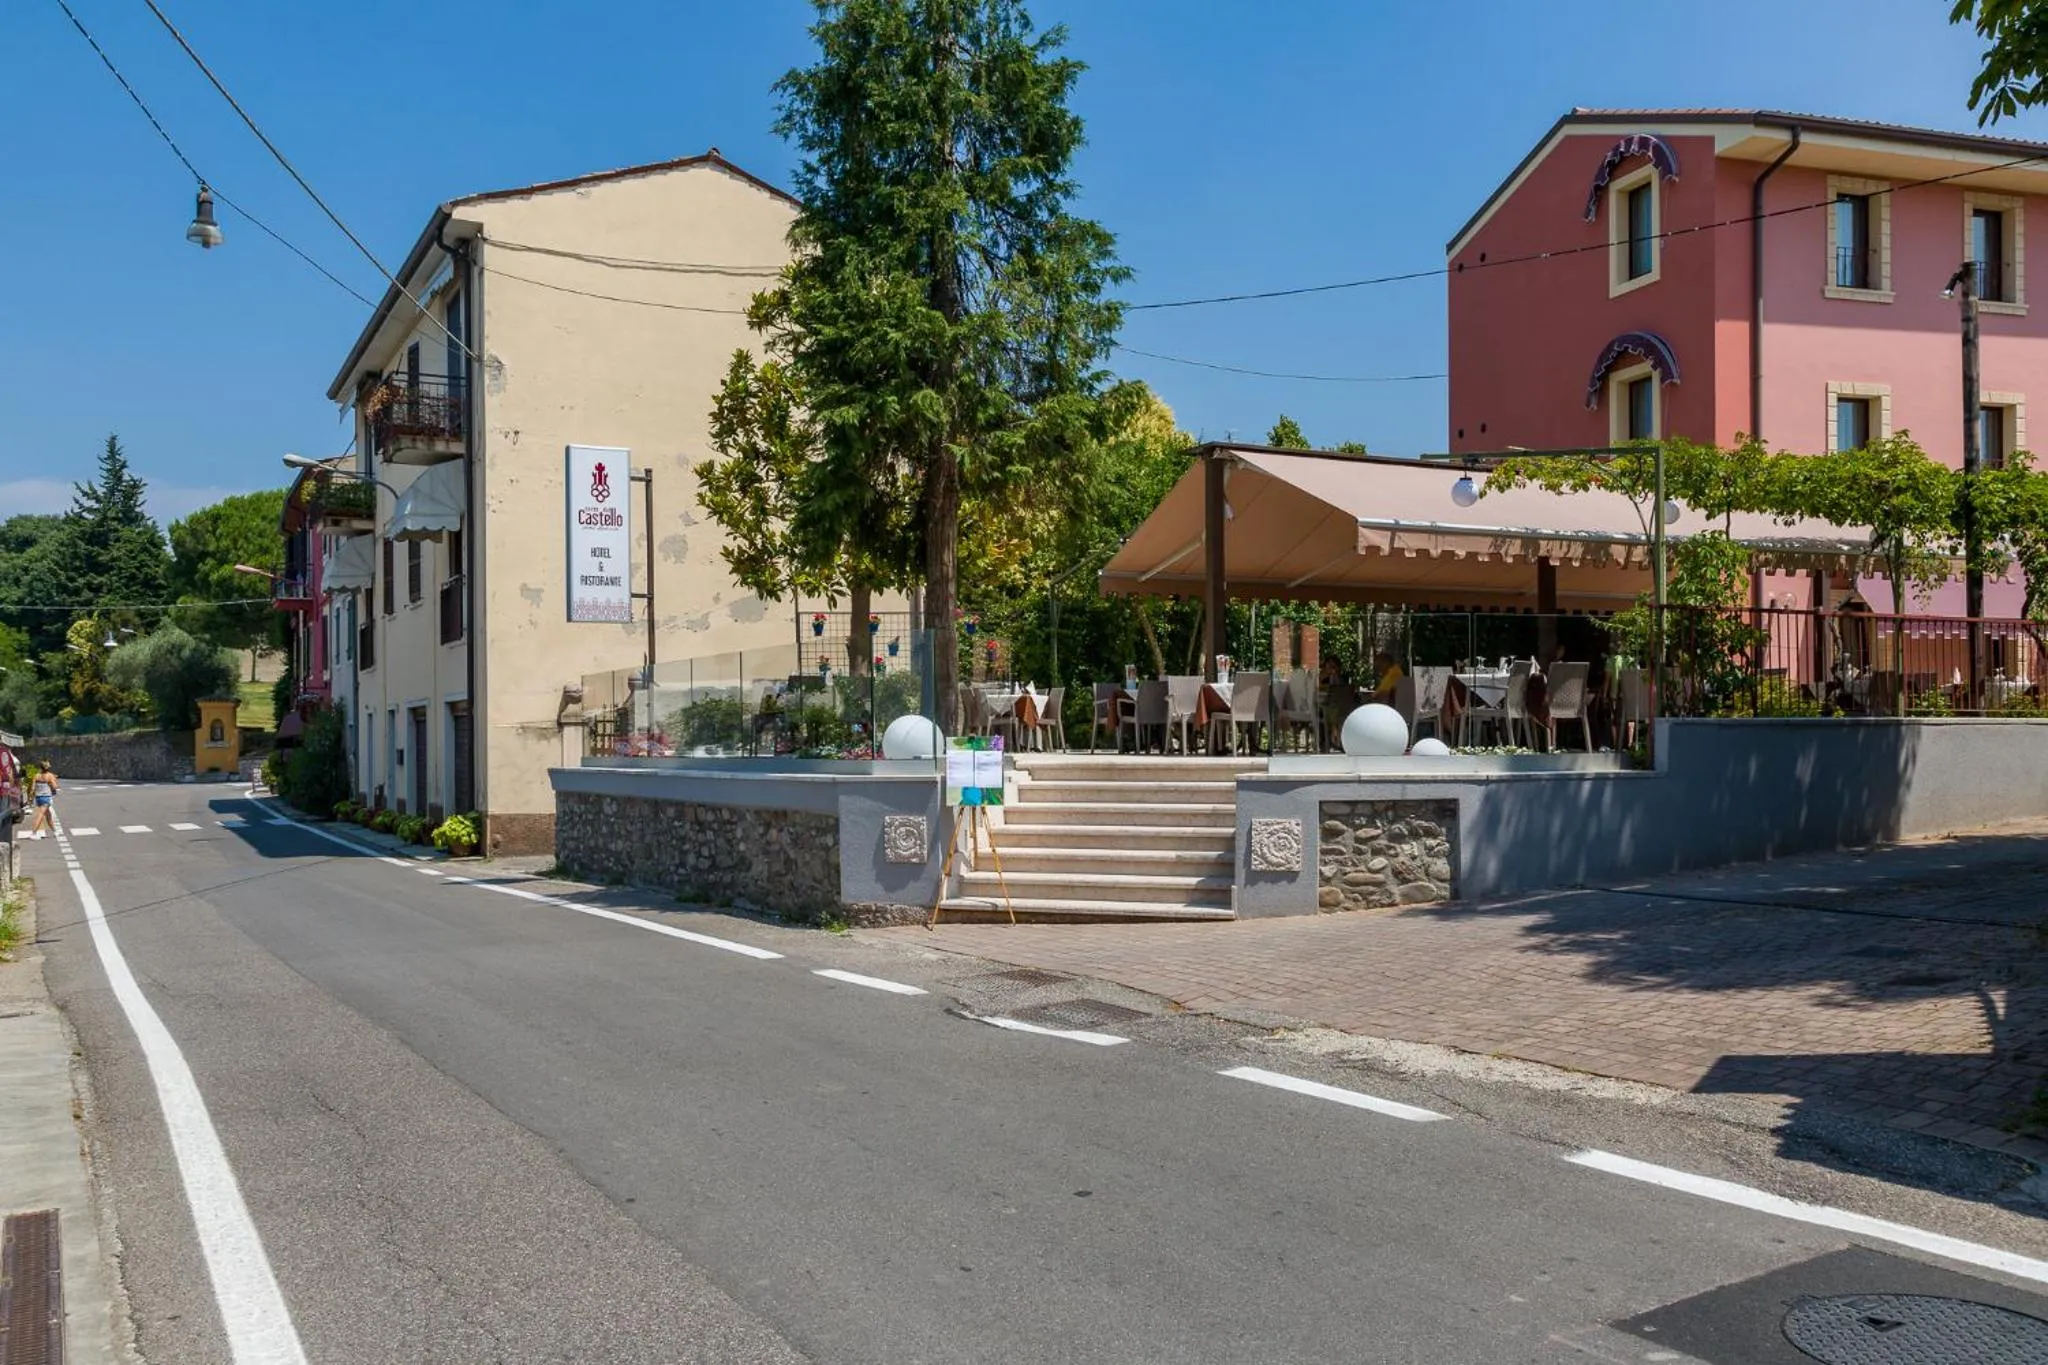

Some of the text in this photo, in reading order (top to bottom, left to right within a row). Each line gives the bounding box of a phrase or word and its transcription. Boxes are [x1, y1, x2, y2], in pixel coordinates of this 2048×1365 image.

[578, 508, 623, 527] Castello
[591, 547, 612, 559] HOTEL
[580, 575, 622, 587] RISTORANTE
